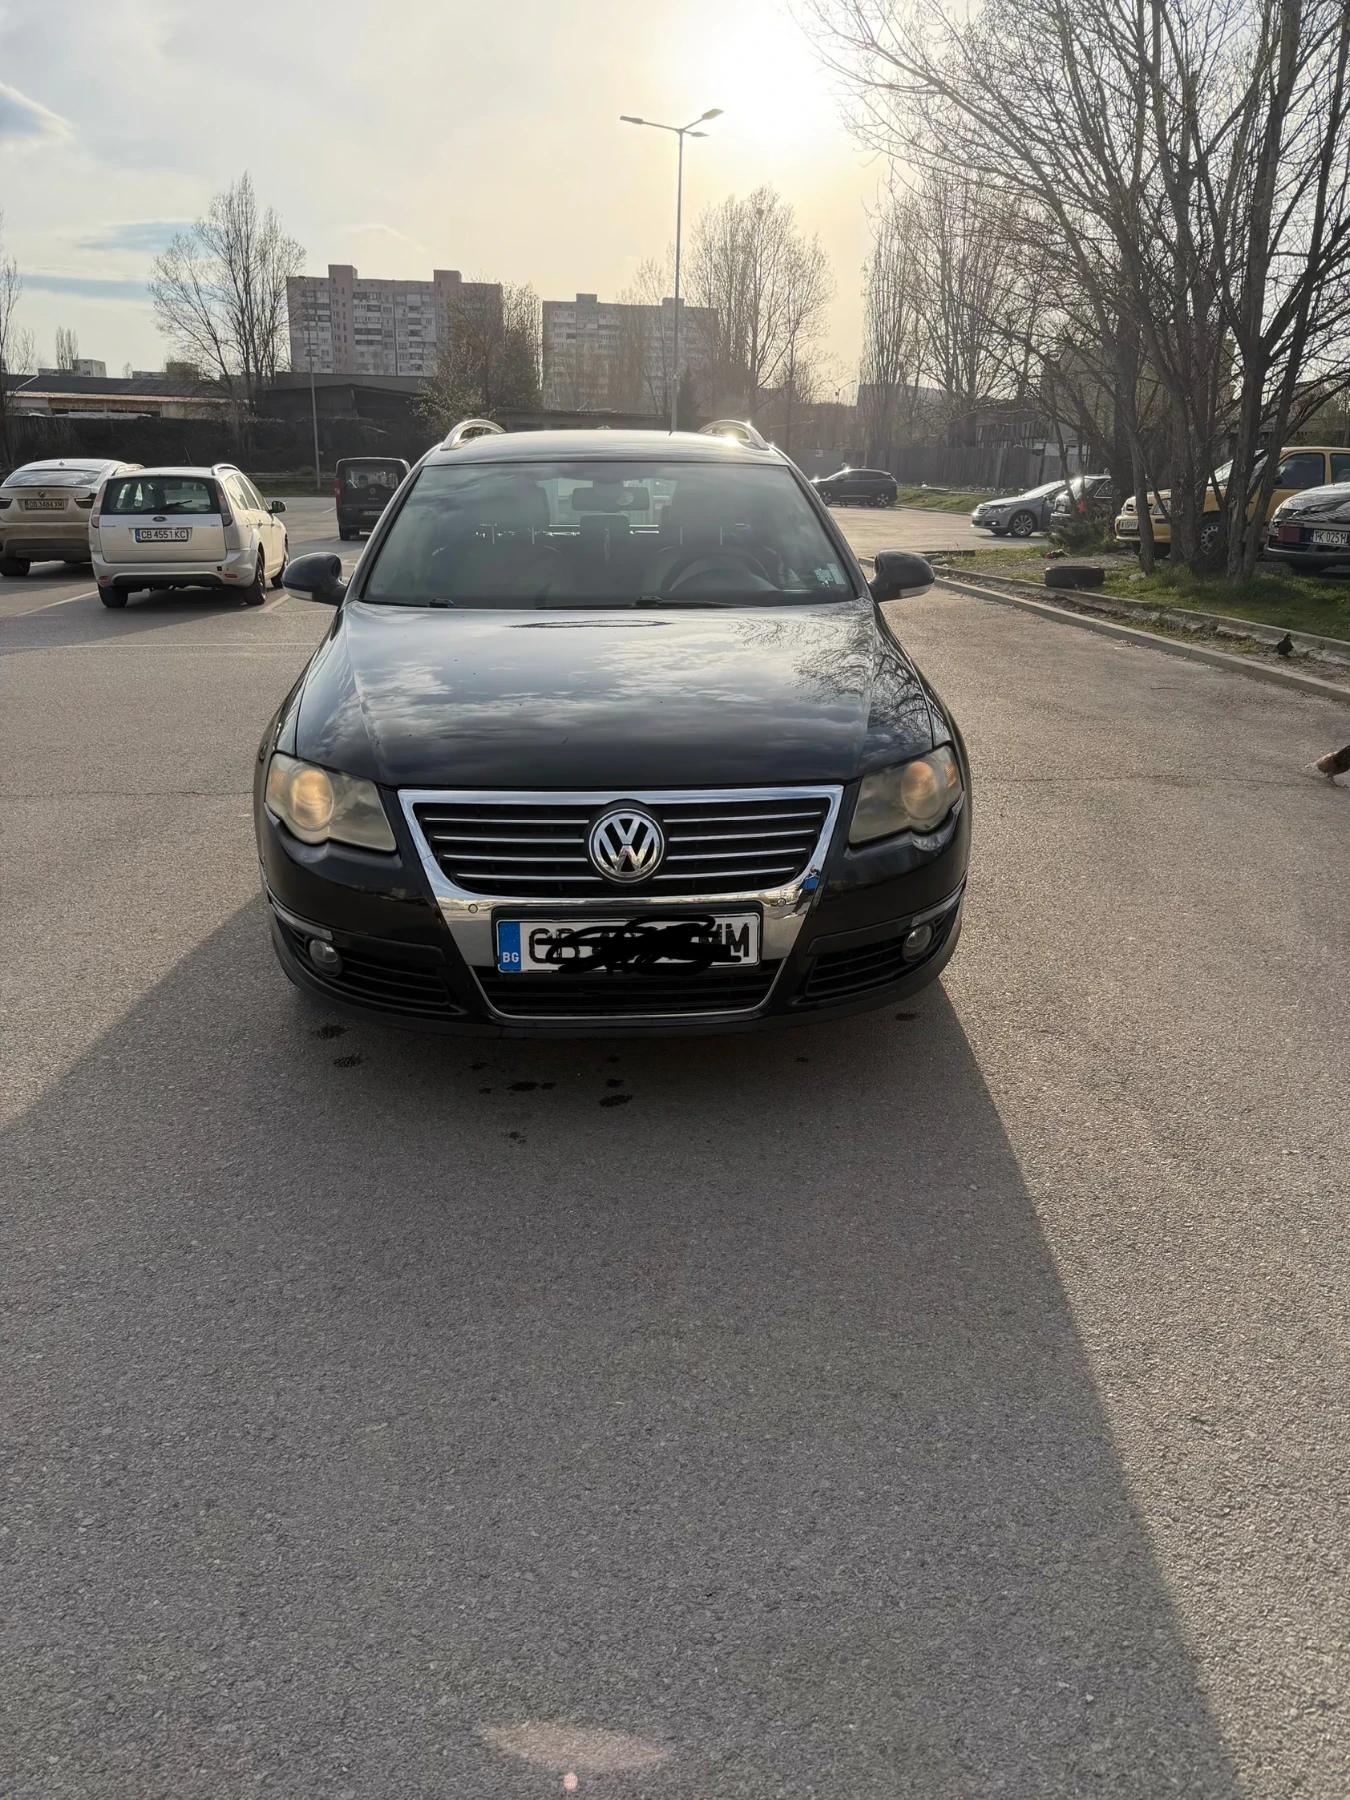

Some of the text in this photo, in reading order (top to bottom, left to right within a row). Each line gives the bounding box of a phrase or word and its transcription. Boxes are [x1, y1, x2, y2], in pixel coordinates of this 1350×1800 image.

[141, 530, 186, 539] CB 4551 KC
[502, 951, 520, 963] BG
